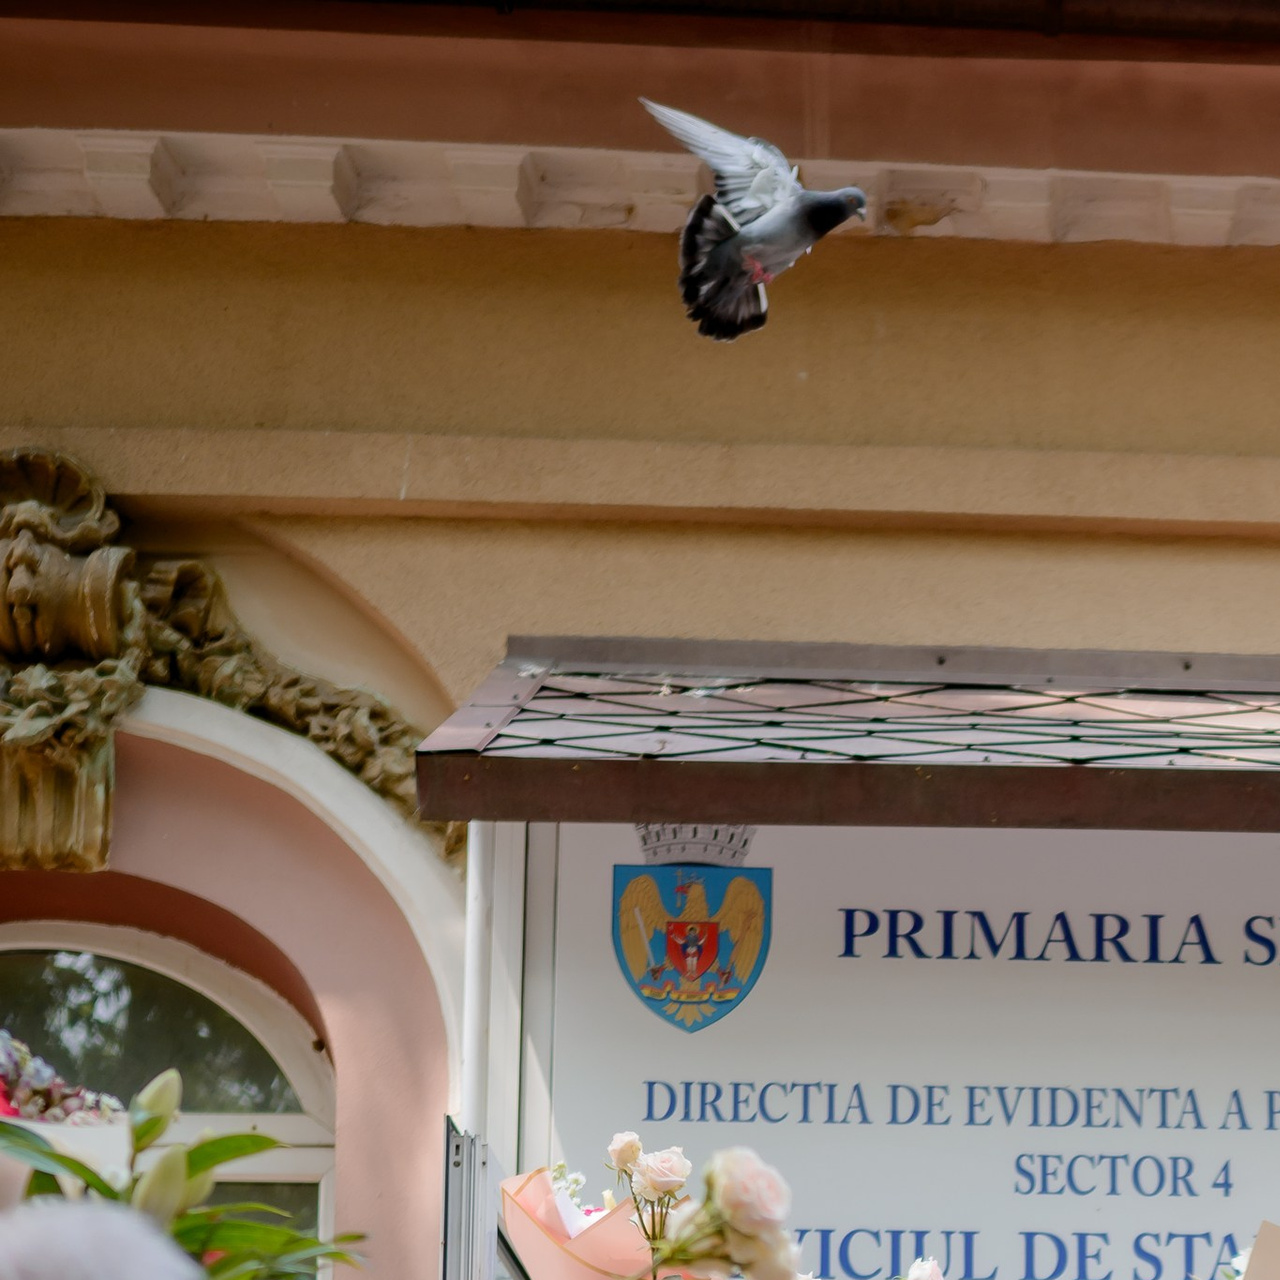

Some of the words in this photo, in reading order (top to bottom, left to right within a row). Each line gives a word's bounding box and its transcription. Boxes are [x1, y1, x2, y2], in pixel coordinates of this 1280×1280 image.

[838, 908, 1222, 965] PRIMARIA
[642, 1080, 873, 1125] DIRECTIA
[886, 1084, 952, 1126] DE
[964, 1086, 1208, 1130] EVIDENTA
[1219, 1089, 1253, 1131] A
[1014, 1153, 1200, 1198] SECTOR
[1211, 1159, 1234, 1198] 4
